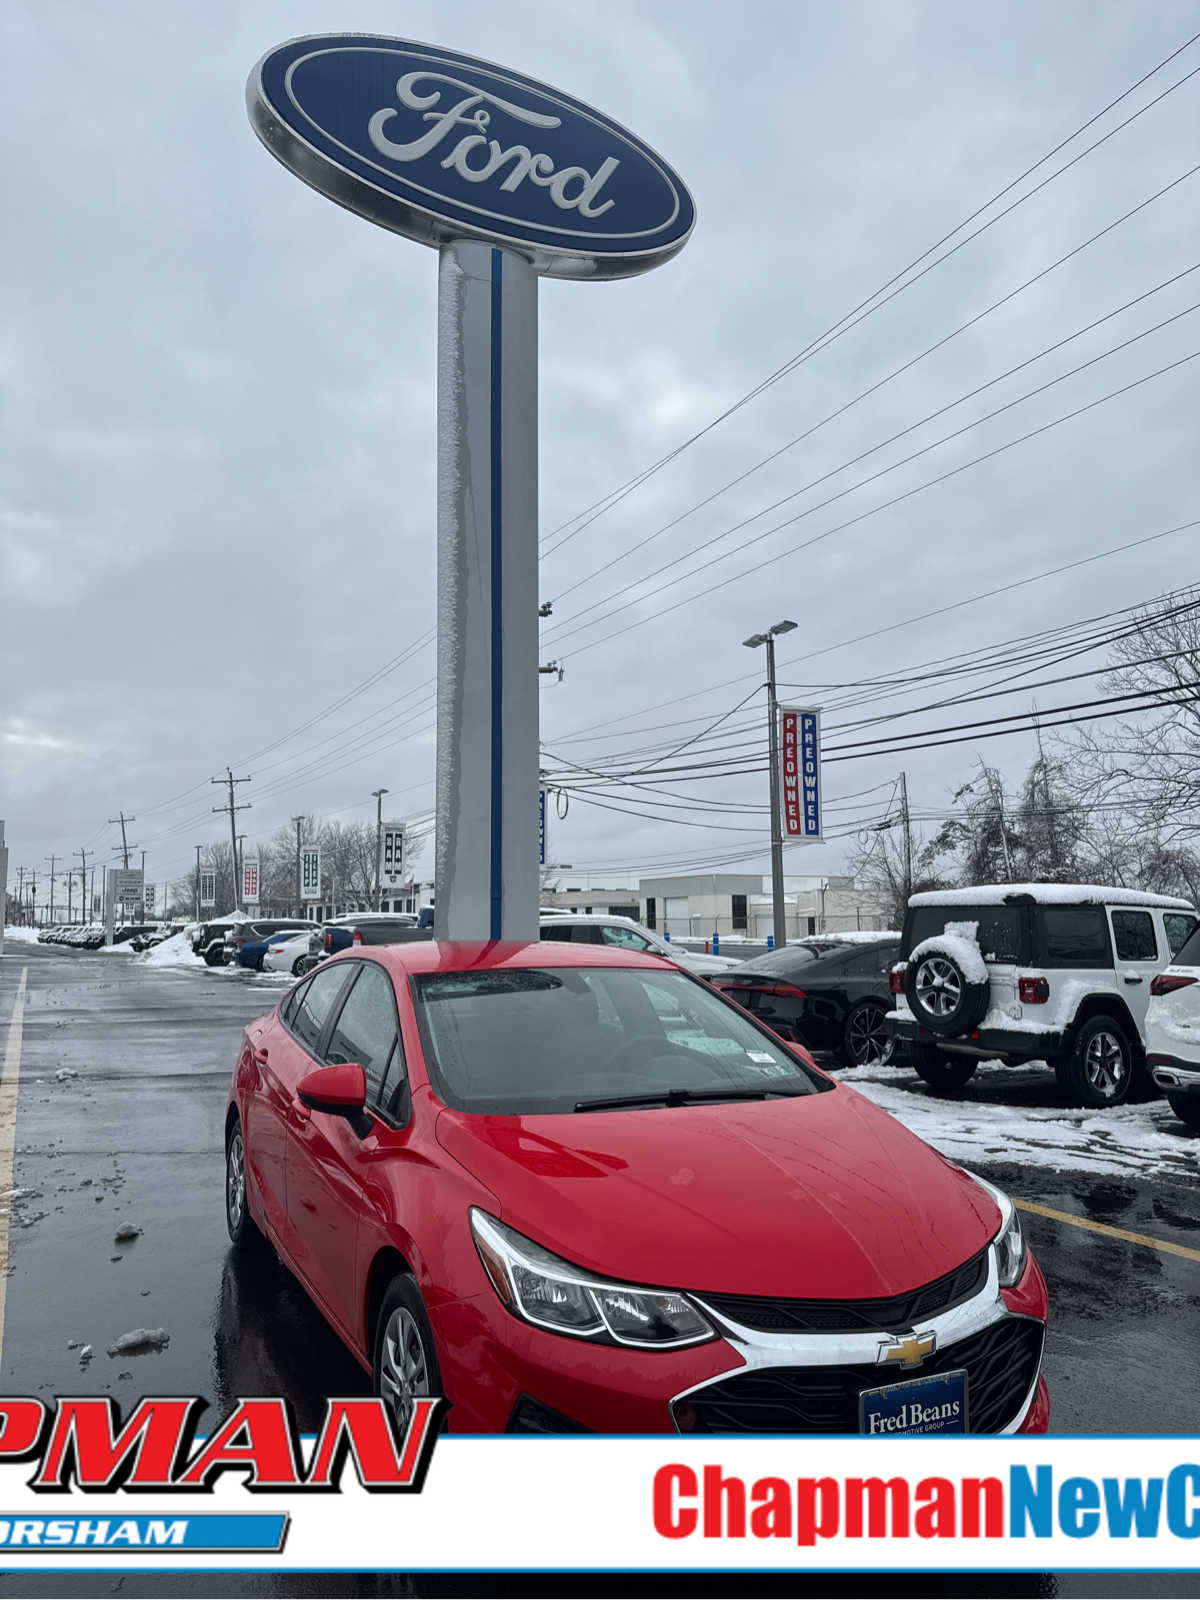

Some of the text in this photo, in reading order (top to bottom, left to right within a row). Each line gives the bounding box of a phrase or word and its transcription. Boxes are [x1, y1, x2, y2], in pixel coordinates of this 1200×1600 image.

[367, 71, 621, 218] Ford
[784, 718, 798, 831] PREOWNED
[804, 718, 817, 831] PREOWNED
[868, 1400, 960, 1435] Fred Beans
